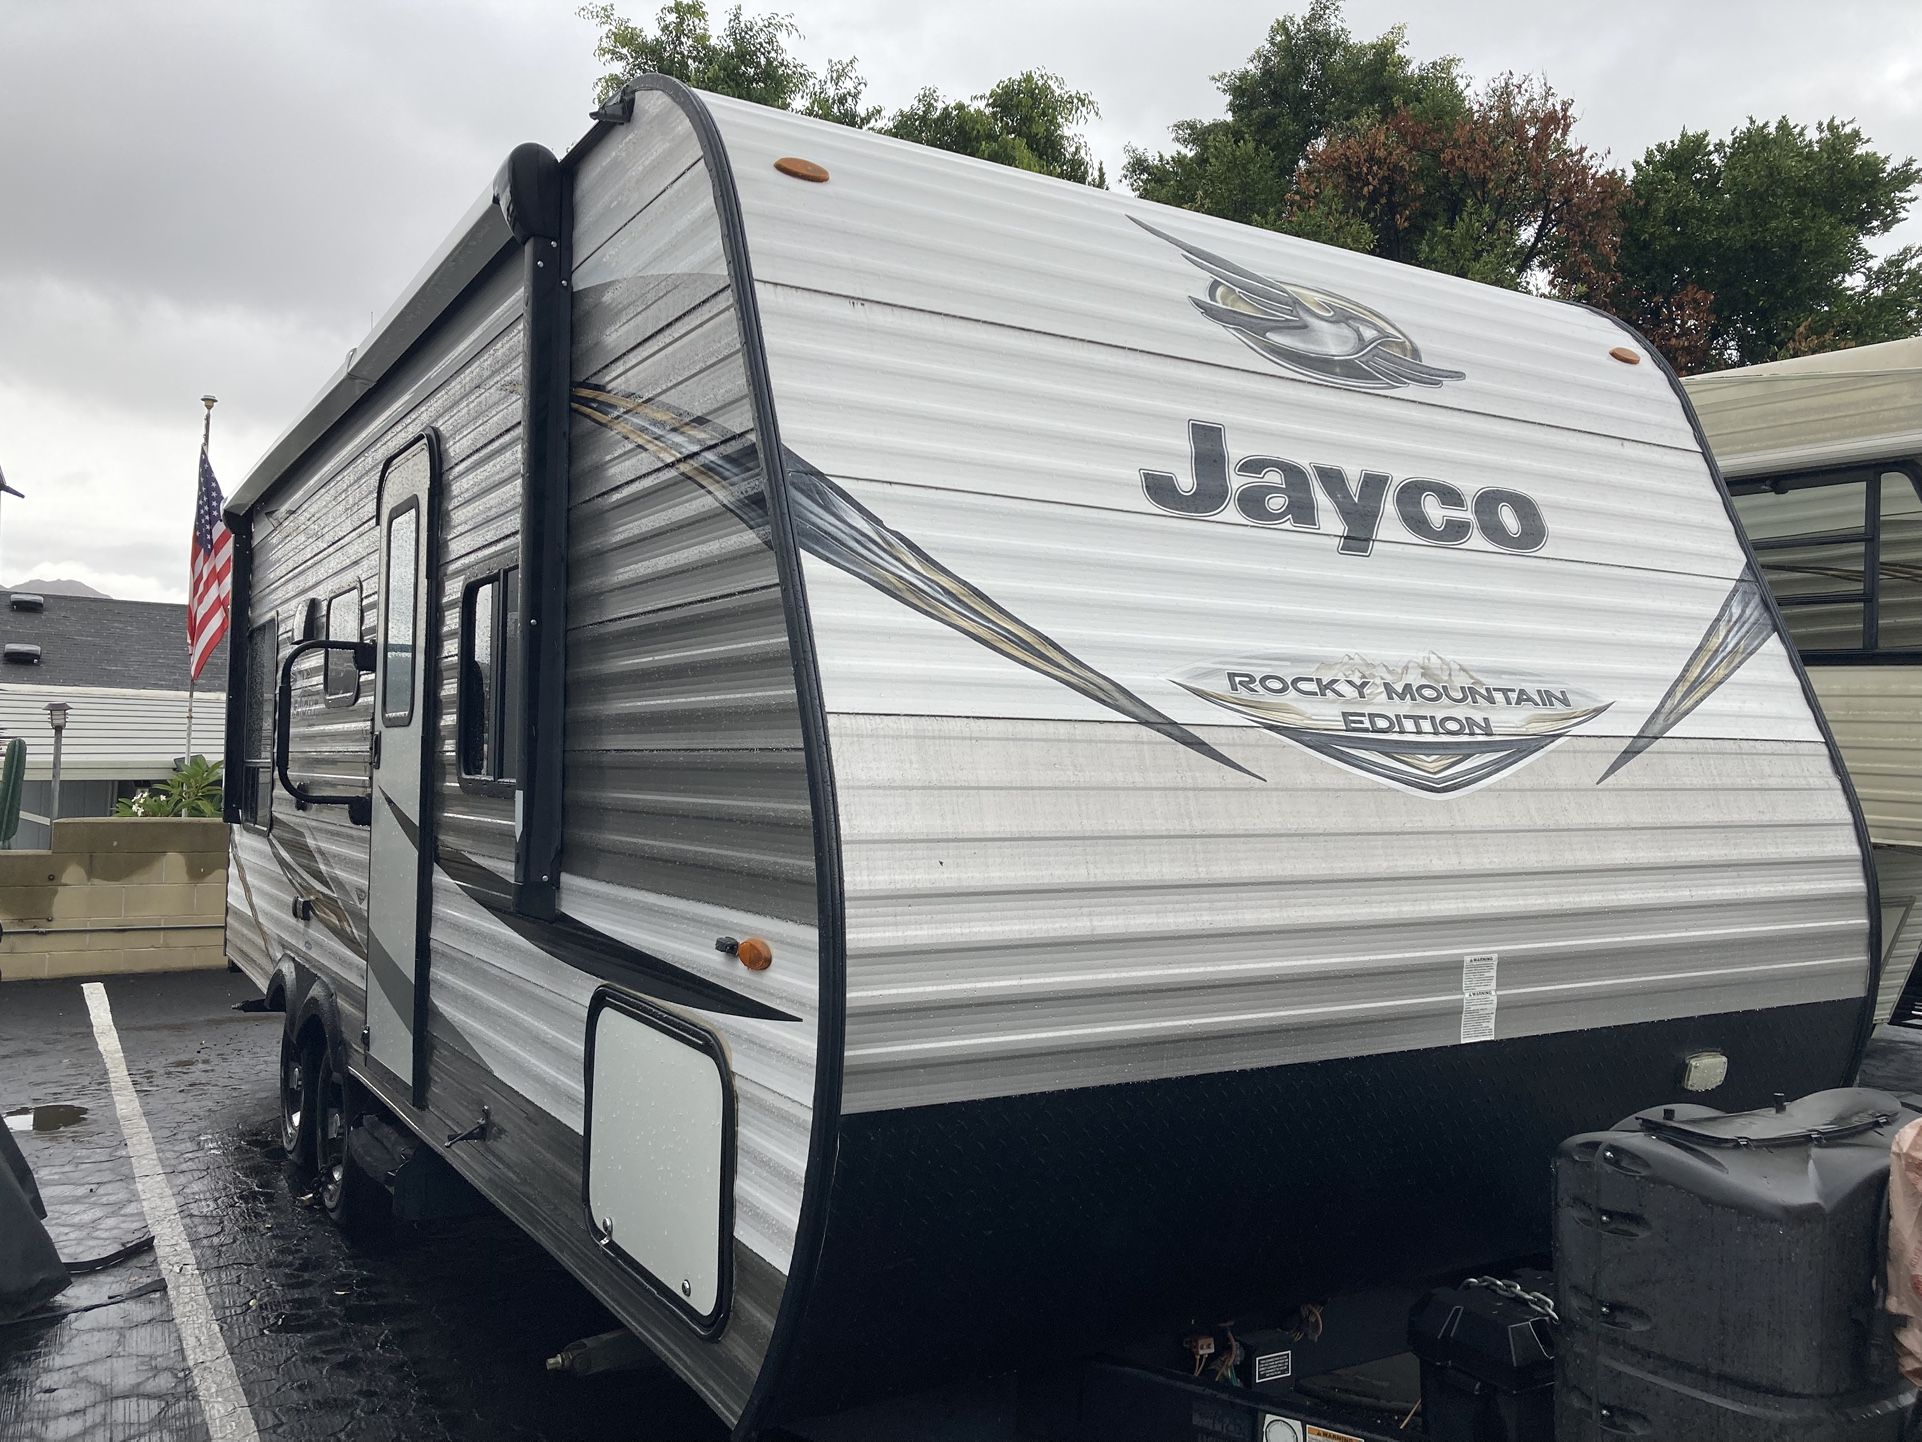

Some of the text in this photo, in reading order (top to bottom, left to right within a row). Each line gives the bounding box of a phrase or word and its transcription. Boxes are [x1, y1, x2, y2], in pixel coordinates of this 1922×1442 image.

[1139, 419, 1549, 557] Jayco
[1227, 671, 1572, 708] ROCKY MOUNTAIN
[1341, 711, 1494, 736] EDITION
